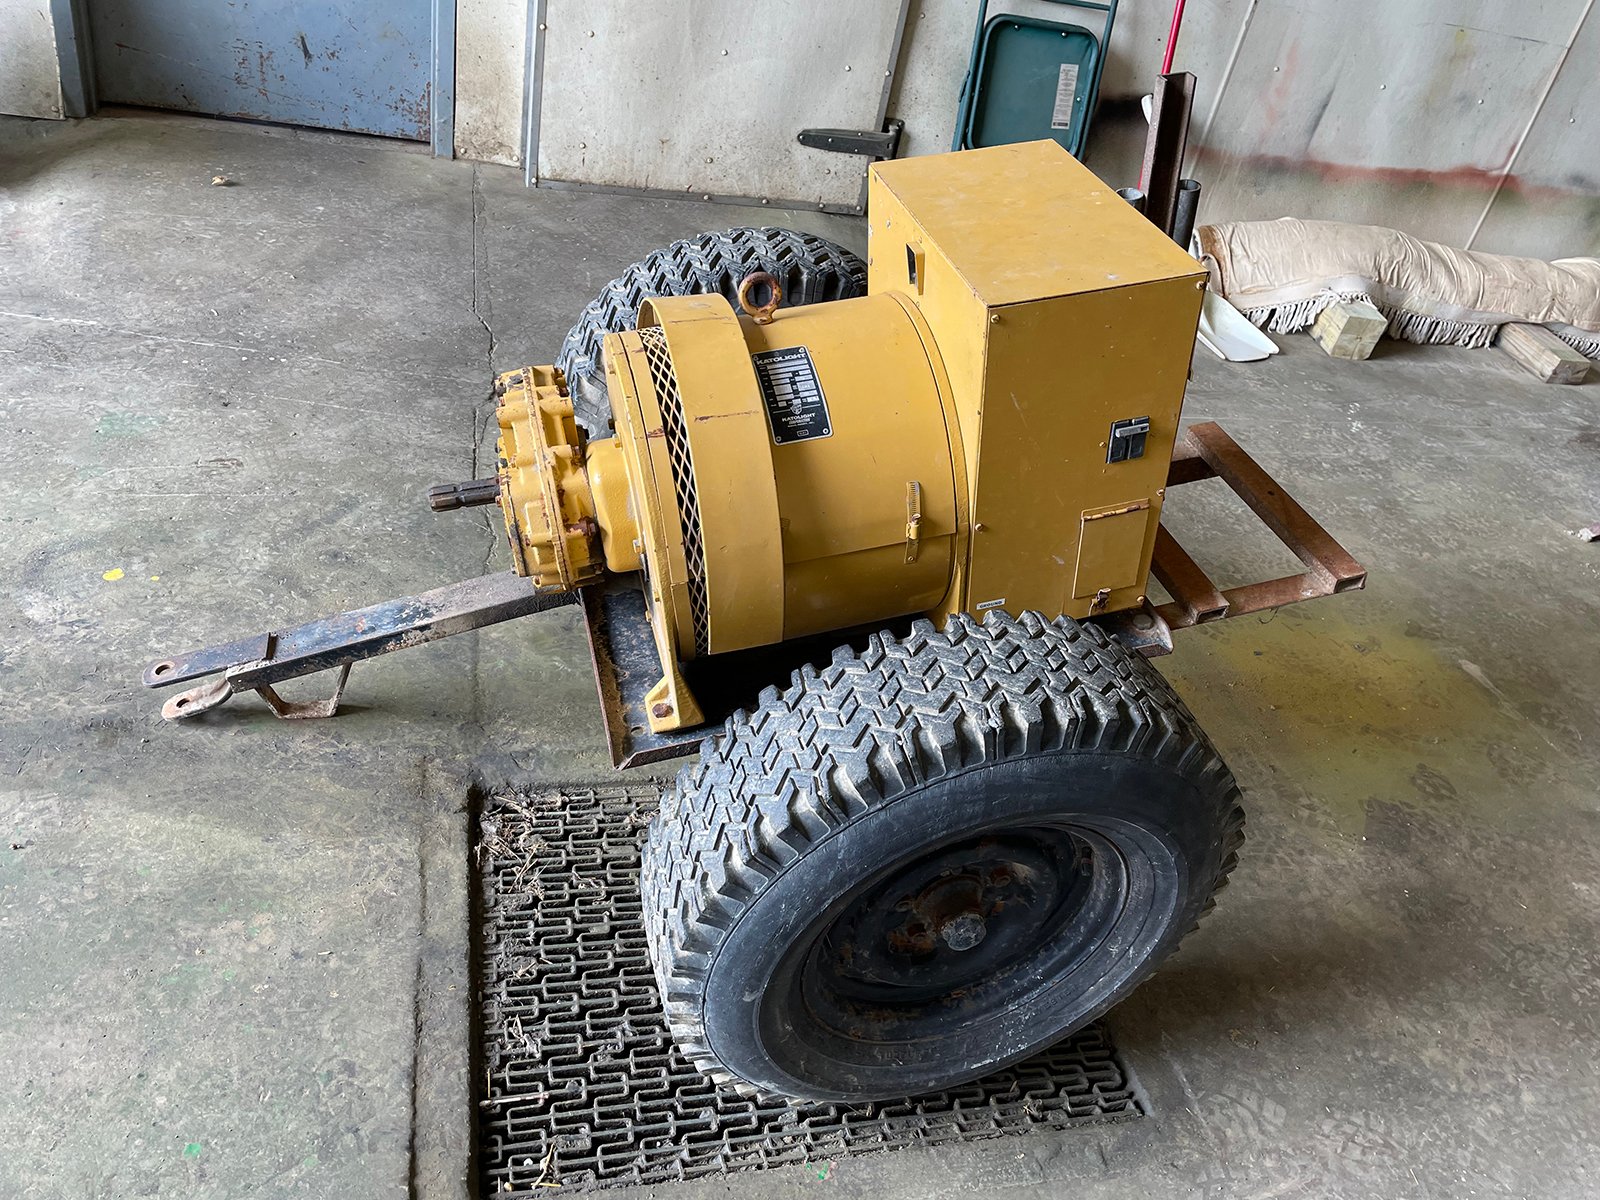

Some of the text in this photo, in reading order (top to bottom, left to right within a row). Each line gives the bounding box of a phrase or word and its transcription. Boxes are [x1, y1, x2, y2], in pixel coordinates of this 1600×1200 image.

[757, 353, 806, 365] KATOLIGHT
[782, 413, 815, 422] KATOLIGHT
[979, 600, 1002, 609] GROUND
